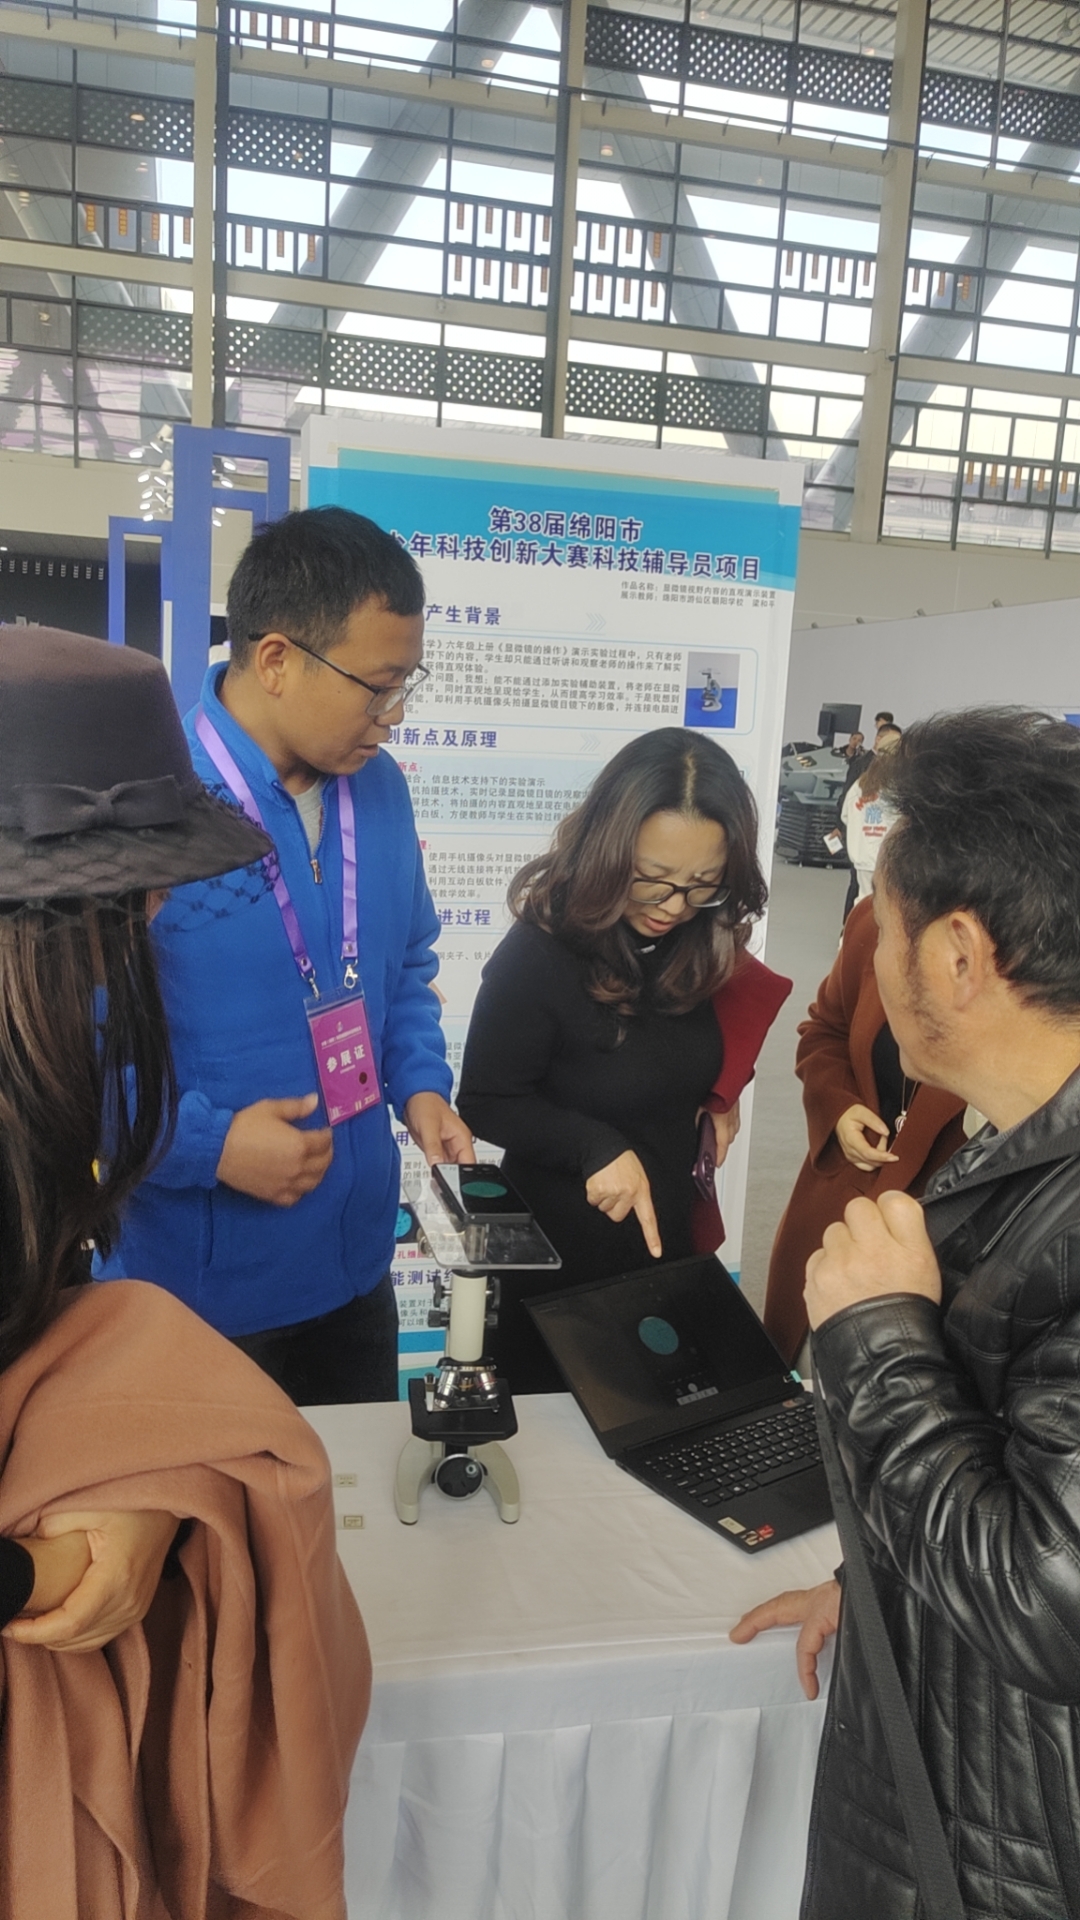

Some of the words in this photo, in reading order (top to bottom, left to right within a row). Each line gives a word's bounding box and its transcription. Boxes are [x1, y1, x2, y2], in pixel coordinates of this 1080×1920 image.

[489, 505, 643, 542] 第38届绵阳市
[426, 604, 501, 625] 产生背景
